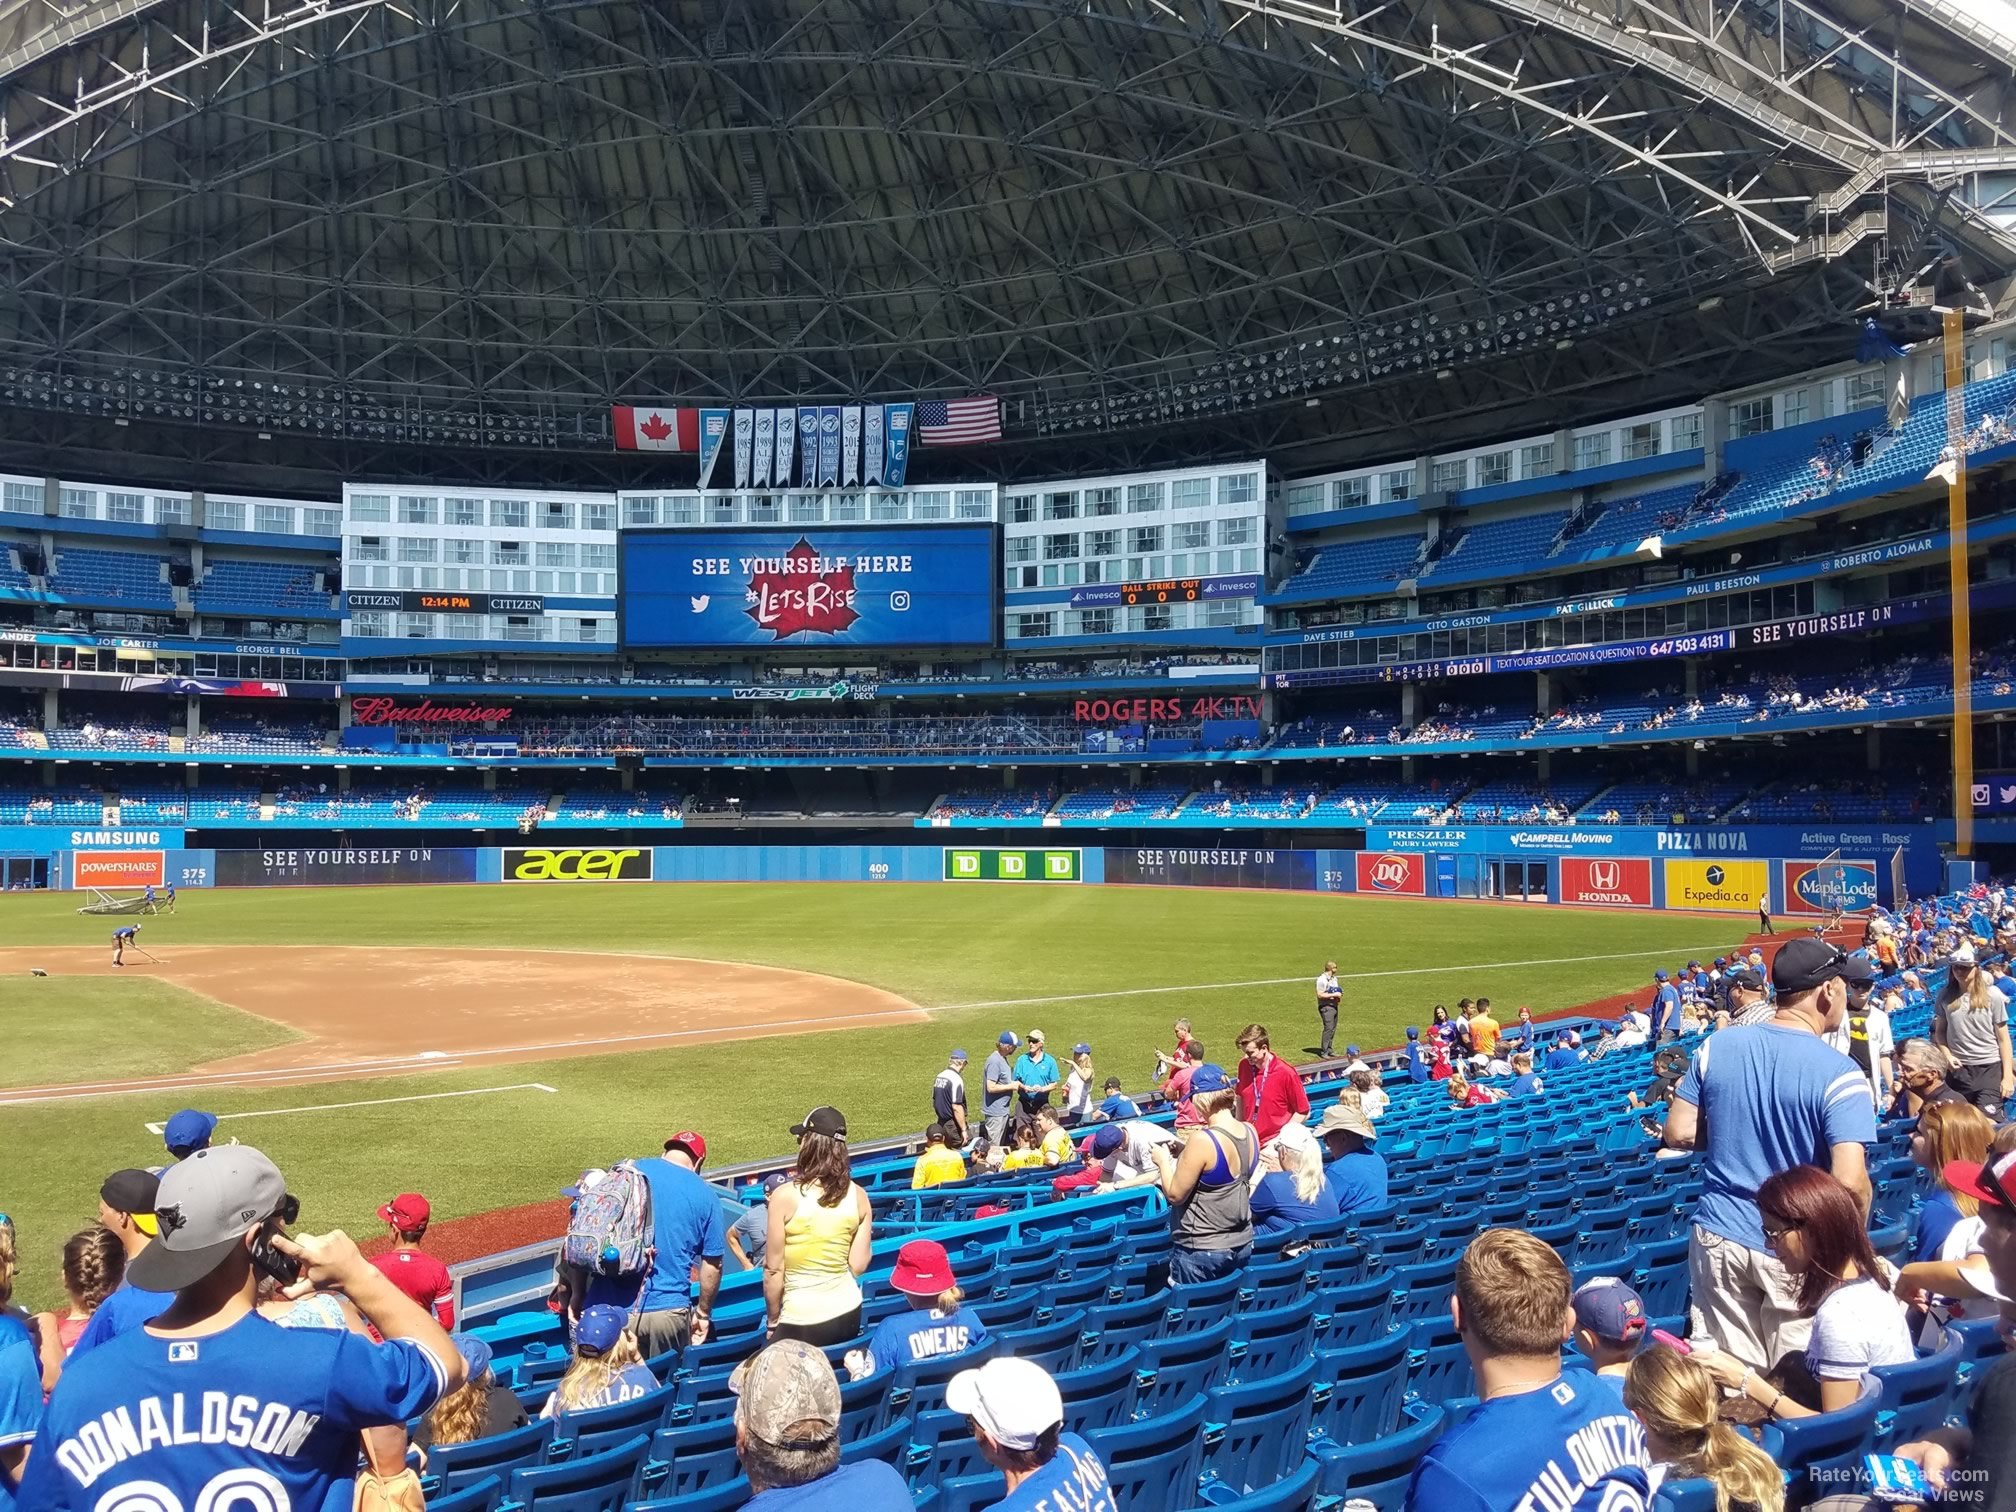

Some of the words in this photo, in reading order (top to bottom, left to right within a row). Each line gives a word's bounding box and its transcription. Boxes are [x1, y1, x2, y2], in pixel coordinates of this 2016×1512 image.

[756, 436, 772, 448] 1989
[780, 436, 792, 448] 1991
[802, 436, 816, 448] 1992
[822, 436, 838, 448] 1993
[866, 434, 882, 446] 2016
[1834, 550, 1881, 568] ROBERTO
[1886, 540, 1932, 558] ALOMAR
[692, 558, 730, 575] SEE
[740, 557, 847, 574] YOURSELF
[857, 556, 912, 572] HERE
[1122, 584, 1142, 592] BALL
[1146, 582, 1176, 591] STRIKE
[1180, 580, 1200, 589] OUT
[1219, 582, 1256, 591] Invesco
[1687, 584, 1710, 595] PAUL
[1714, 574, 1760, 591] BEESTON
[348, 595, 400, 606] CITIZEN
[421, 597, 448, 607] 12:14
[452, 597, 470, 608] PM
[1086, 592, 1120, 600] Invesco
[1128, 594, 1136, 604] 0
[1158, 592, 1166, 602] 0
[1187, 590, 1196, 600] 0
[490, 600, 541, 610] CITIZEN
[1556, 605, 1572, 614] PAT
[1578, 598, 1614, 612] GILLICK
[1427, 621, 1447, 630] CITO
[1452, 616, 1490, 628] GASTON
[1753, 626, 1780, 644] SEE
[1787, 612, 1864, 637] YOURSELF
[1872, 606, 1892, 621] ON
[96, 638, 117, 647] JOE
[121, 640, 159, 648] CARTER
[1304, 633, 1326, 642] DAVE
[1330, 631, 1354, 640] STIEB
[236, 645, 275, 654] GEORGE
[280, 646, 301, 655] BELL
[1496, 658, 1510, 669] TEXT
[1509, 656, 1532, 668] YOUR
[1534, 654, 1551, 665] SEAT
[1551, 652, 1588, 664] LOCATION
[1590, 652, 1596, 660] &
[1596, 648, 1635, 661] QUESTION
[1636, 646, 1646, 656] TO
[1650, 642, 1674, 656] 647
[1676, 638, 1697, 652] 503
[1700, 635, 1724, 649] 4131
[734, 687, 829, 700] WESTJET
[352, 697, 512, 724] Budweiser
[1075, 698, 1182, 720] ROGERS
[71, 832, 160, 845] SAMSUNG
[1388, 830, 1466, 840] PRESZLER
[1520, 832, 1570, 843] CAMPBELL
[1572, 832, 1614, 844] MOVING
[1658, 832, 1702, 850] PIZZA
[1708, 832, 1748, 851] NOVA
[1800, 833, 1835, 844] Active
[1840, 833, 1872, 844] Green
[1882, 833, 1910, 844] Ross
[264, 852, 297, 866] SEE
[306, 850, 400, 864] YOURSELF
[410, 850, 432, 862] ON
[955, 856, 978, 872] TD
[1000, 856, 1023, 873] TD
[1048, 856, 1070, 873] TD
[1138, 850, 1164, 866] SEE
[1169, 850, 1248, 866] YOURSELF
[1255, 850, 1275, 864] ON
[81, 862, 158, 875] powerSHARES
[515, 850, 640, 880] acer
[869, 864, 888, 874] 400
[182, 868, 206, 879] 375
[1324, 870, 1342, 881] 375
[1378, 864, 1403, 883] DQ
[1802, 880, 1842, 896] Maple
[1578, 892, 1632, 903] HONDA
[1685, 888, 1749, 904] Expedia.ca
[1828, 896, 1856, 904] FRMS
[908, 1326, 968, 1359] OWENS
[56, 1391, 320, 1488] DONALDSON
